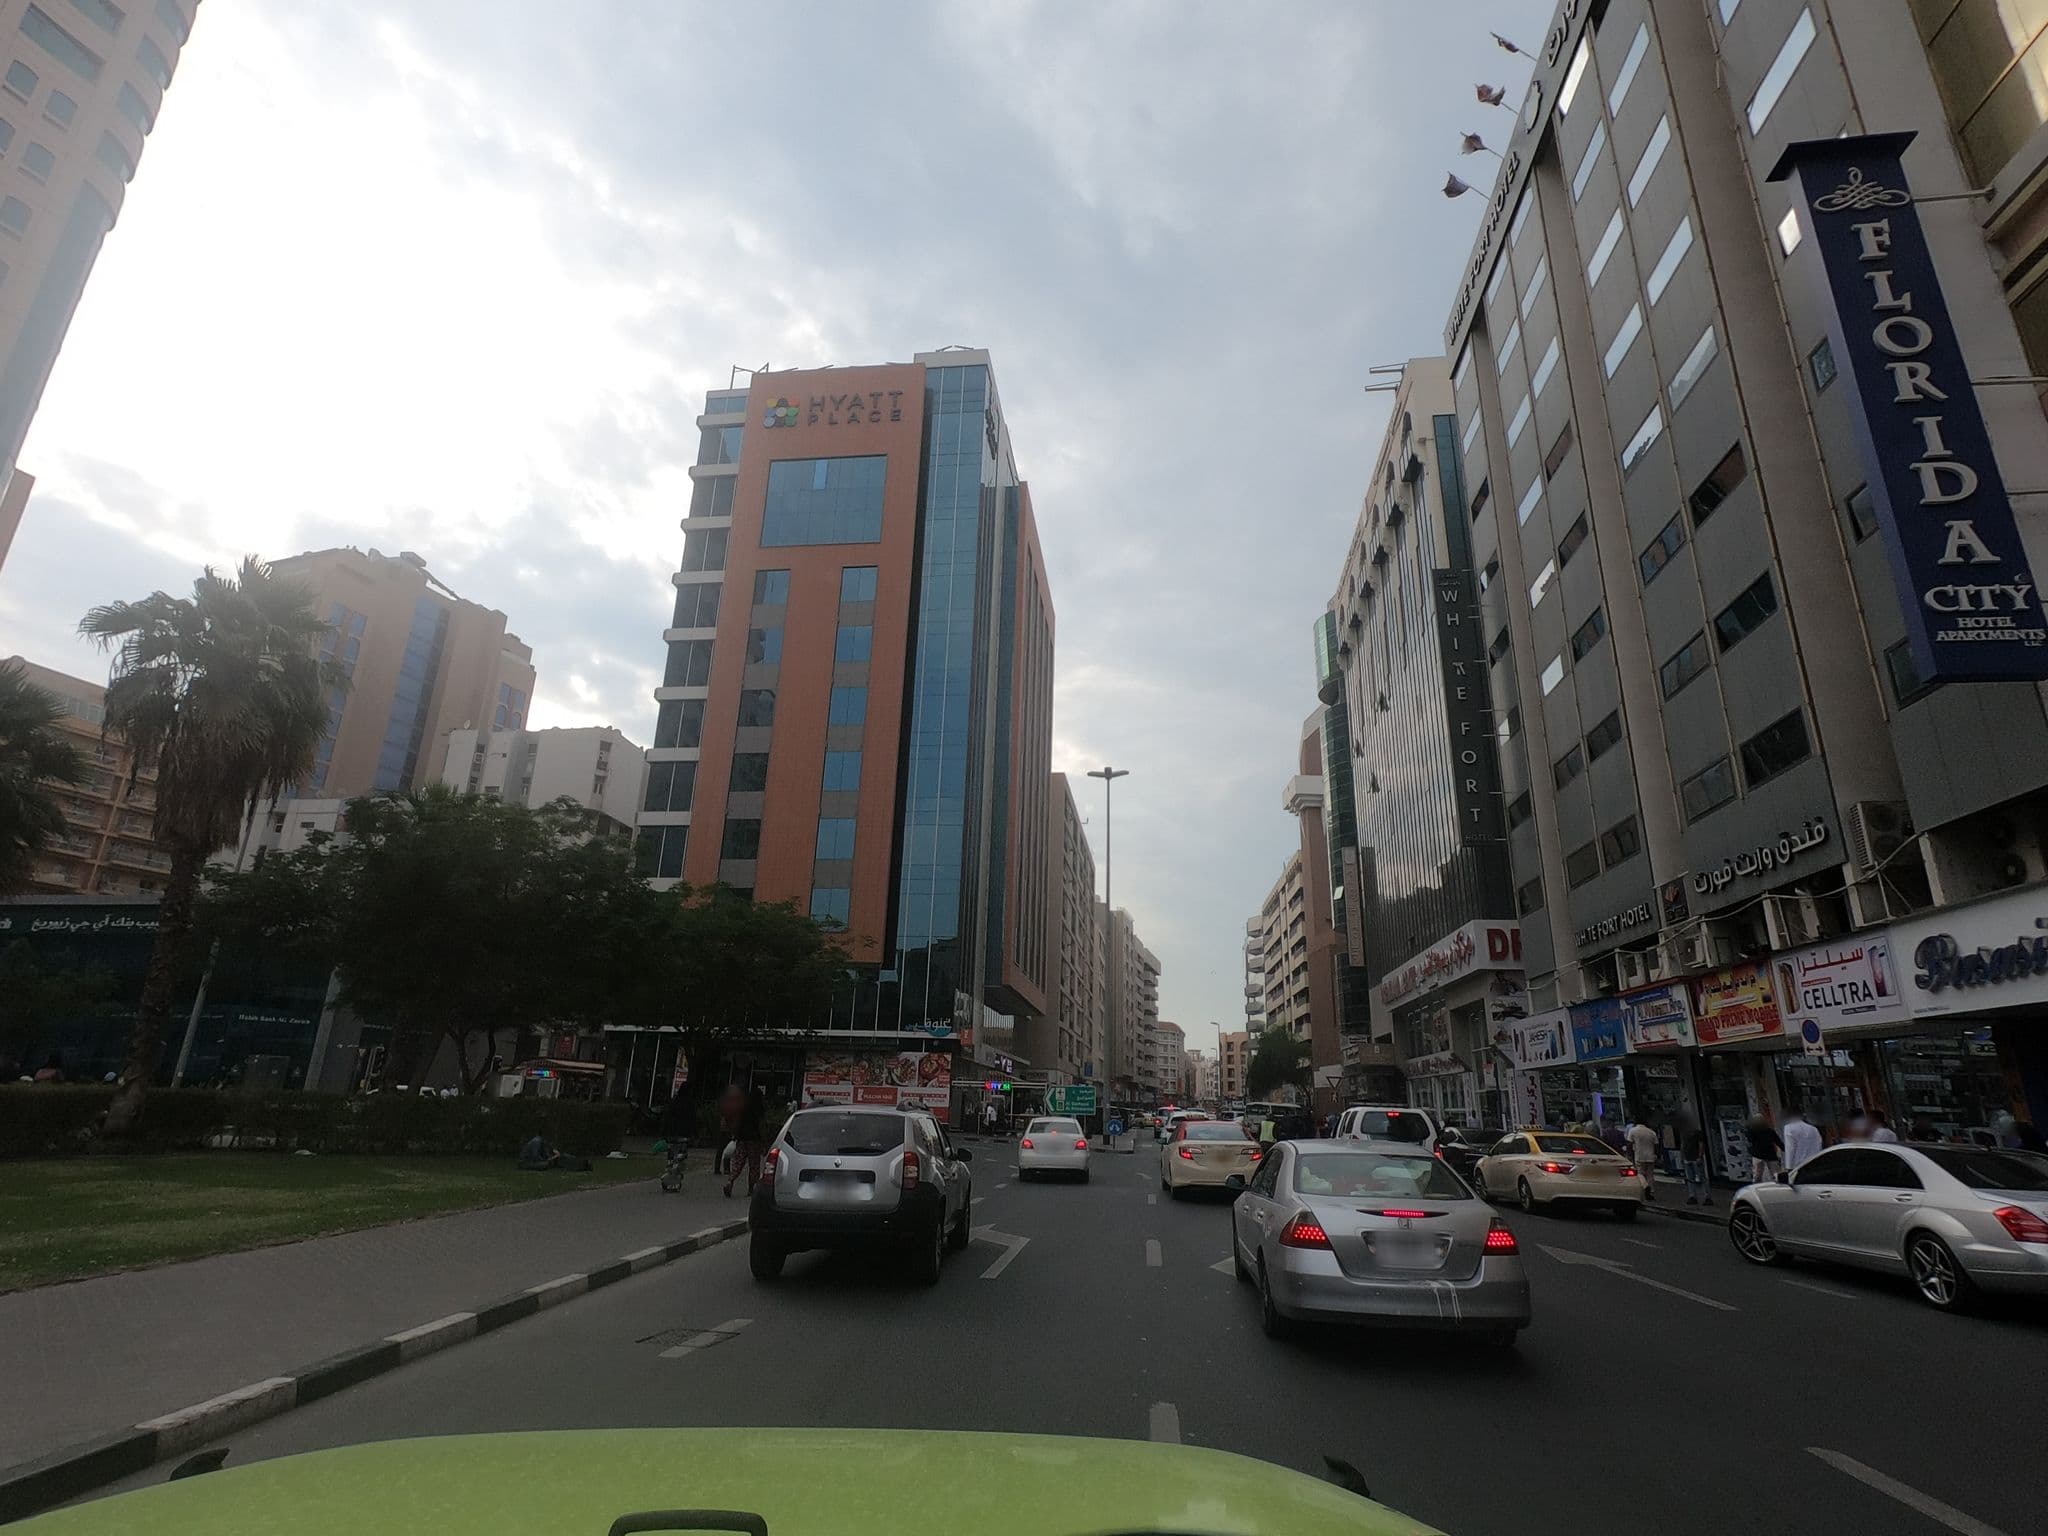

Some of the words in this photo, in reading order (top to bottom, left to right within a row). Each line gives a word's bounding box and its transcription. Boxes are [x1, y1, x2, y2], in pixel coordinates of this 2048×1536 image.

[1448, 285, 1470, 346] WHITE
[1468, 225, 1491, 290] FORT
[1488, 151, 1520, 232] HOTEL
[809, 391, 903, 412] HYATT
[1851, 219, 2001, 565] FLORIDA
[808, 409, 902, 426] PLACE
[1924, 583, 2032, 612] CITY
[1936, 628, 2047, 642] APARTMENTS
[1955, 616, 2016, 629] HOTEL
[1460, 721, 1481, 823] FORT
[1774, 816, 1825, 864] فندق
[1693, 858, 1732, 893] فورت
[1734, 847, 1773, 877] وايت
[1597, 916, 1619, 939] FORT
[1620, 902, 1650, 929] HOTEL
[1803, 979, 1874, 1010] CELLTRA
